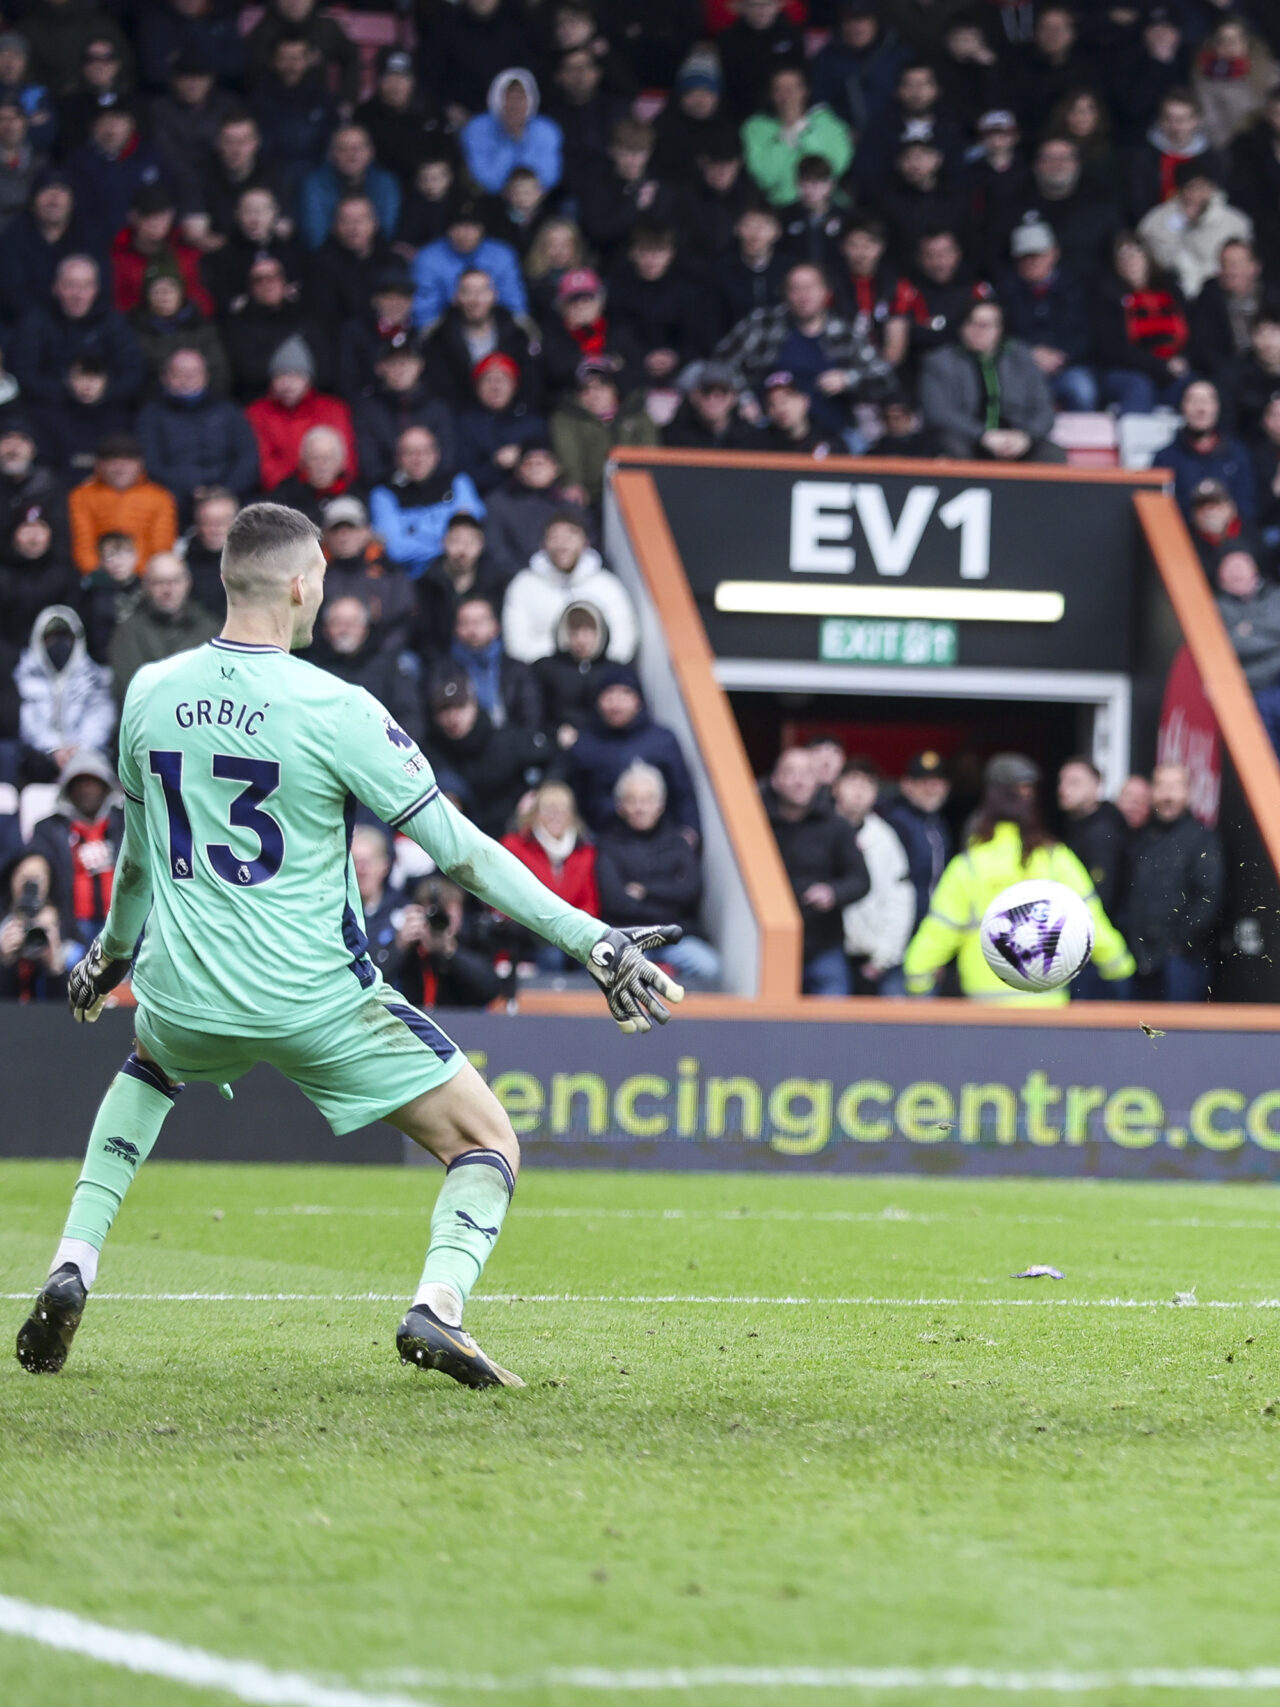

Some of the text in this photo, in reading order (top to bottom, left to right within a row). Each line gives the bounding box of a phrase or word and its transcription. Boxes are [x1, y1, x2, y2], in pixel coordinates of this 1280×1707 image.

[789, 480, 992, 580] EV1
[823, 619, 899, 661] EXIT
[175, 699, 271, 737] GRBIĆ
[148, 749, 285, 887] 13
